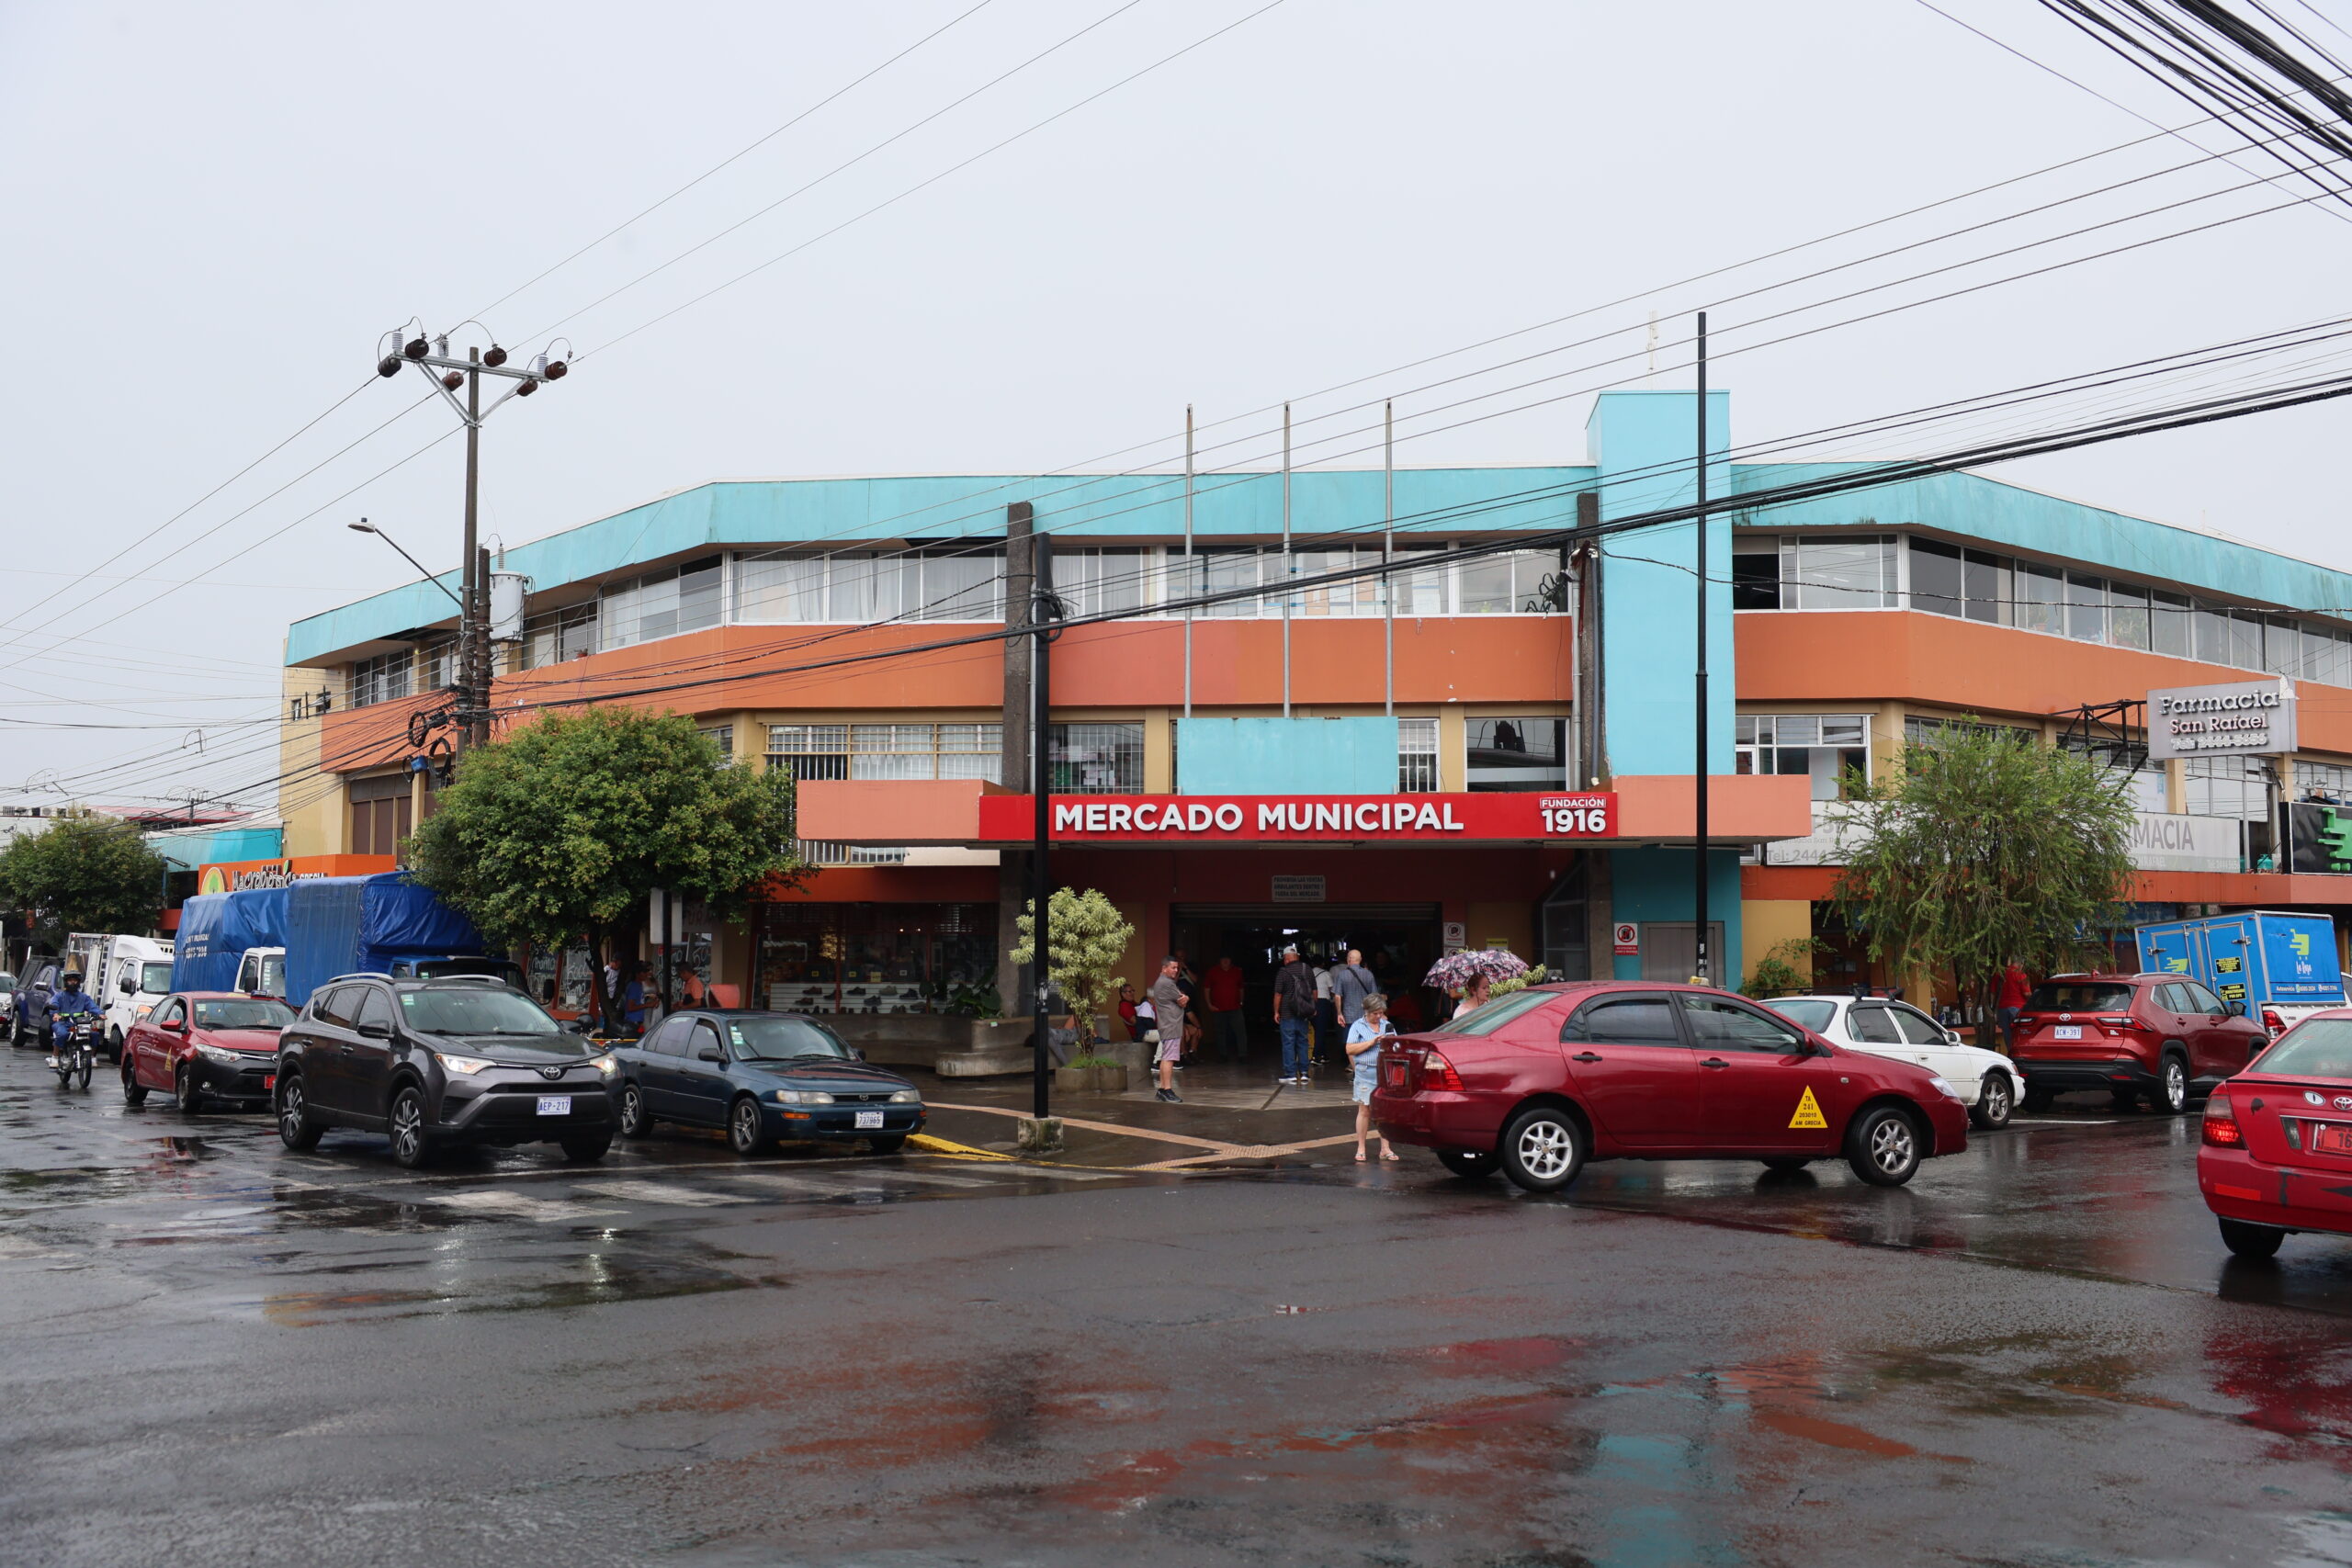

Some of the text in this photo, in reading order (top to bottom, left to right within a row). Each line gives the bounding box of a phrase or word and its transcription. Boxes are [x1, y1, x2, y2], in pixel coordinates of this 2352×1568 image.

[2159, 689, 2279, 715] Farmacia
[2170, 713, 2268, 734] San Rafael
[1542, 795, 1605, 807] FUNDACIÓN
[1055, 802, 1464, 831] MERCADO MUNICIPAL
[1541, 808, 1606, 832] 1916
[1767, 849, 1789, 862] Tel:
